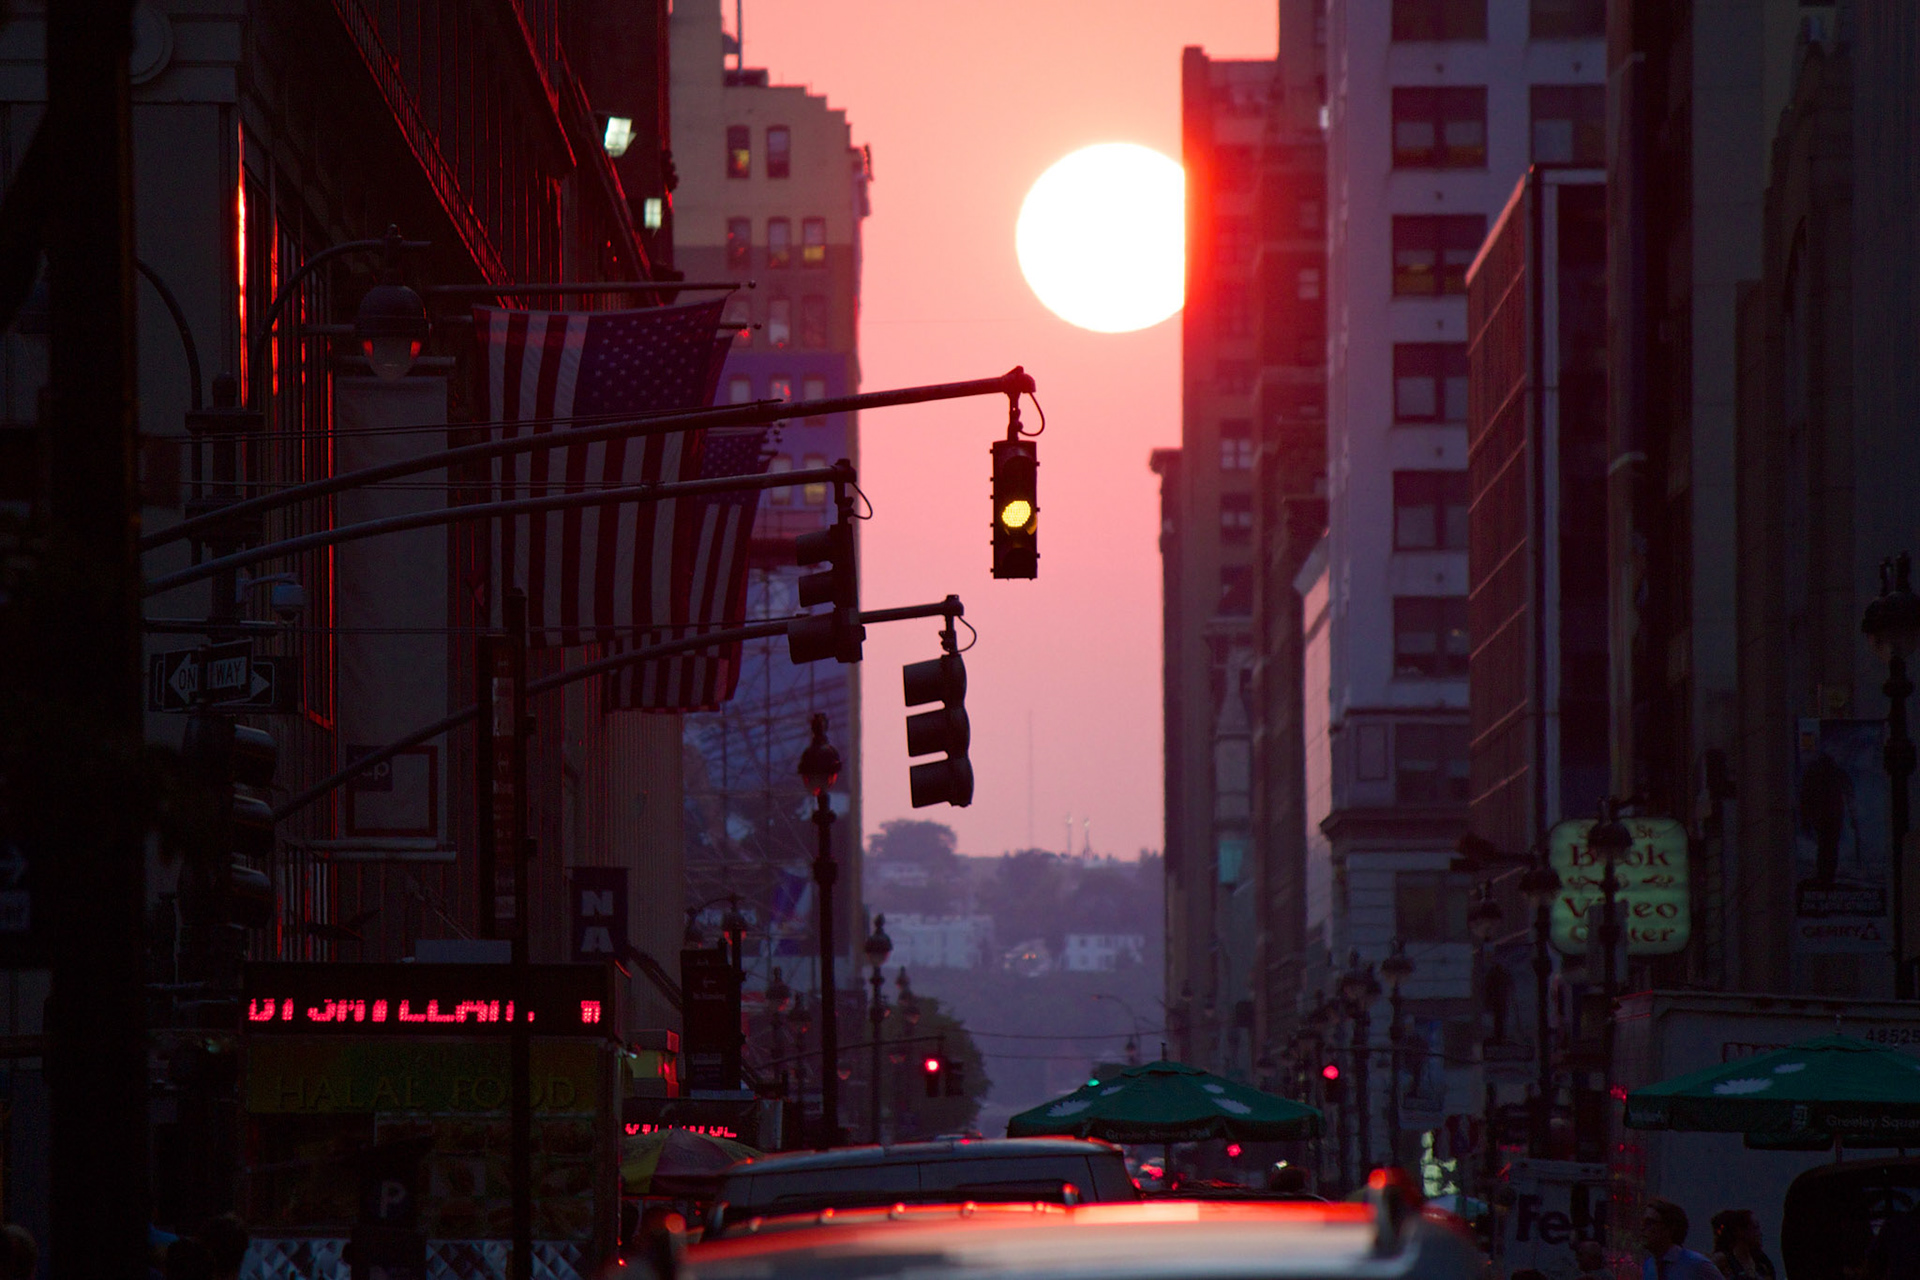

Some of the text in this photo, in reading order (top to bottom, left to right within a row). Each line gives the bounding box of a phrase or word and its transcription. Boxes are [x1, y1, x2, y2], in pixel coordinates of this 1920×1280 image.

[178, 661, 242, 690] ON WAY
[1569, 843, 1672, 867] Bok
[1562, 897, 1678, 919] Veo
[1568, 924, 1676, 944] Cter
[277, 1075, 426, 1110] HALAL
